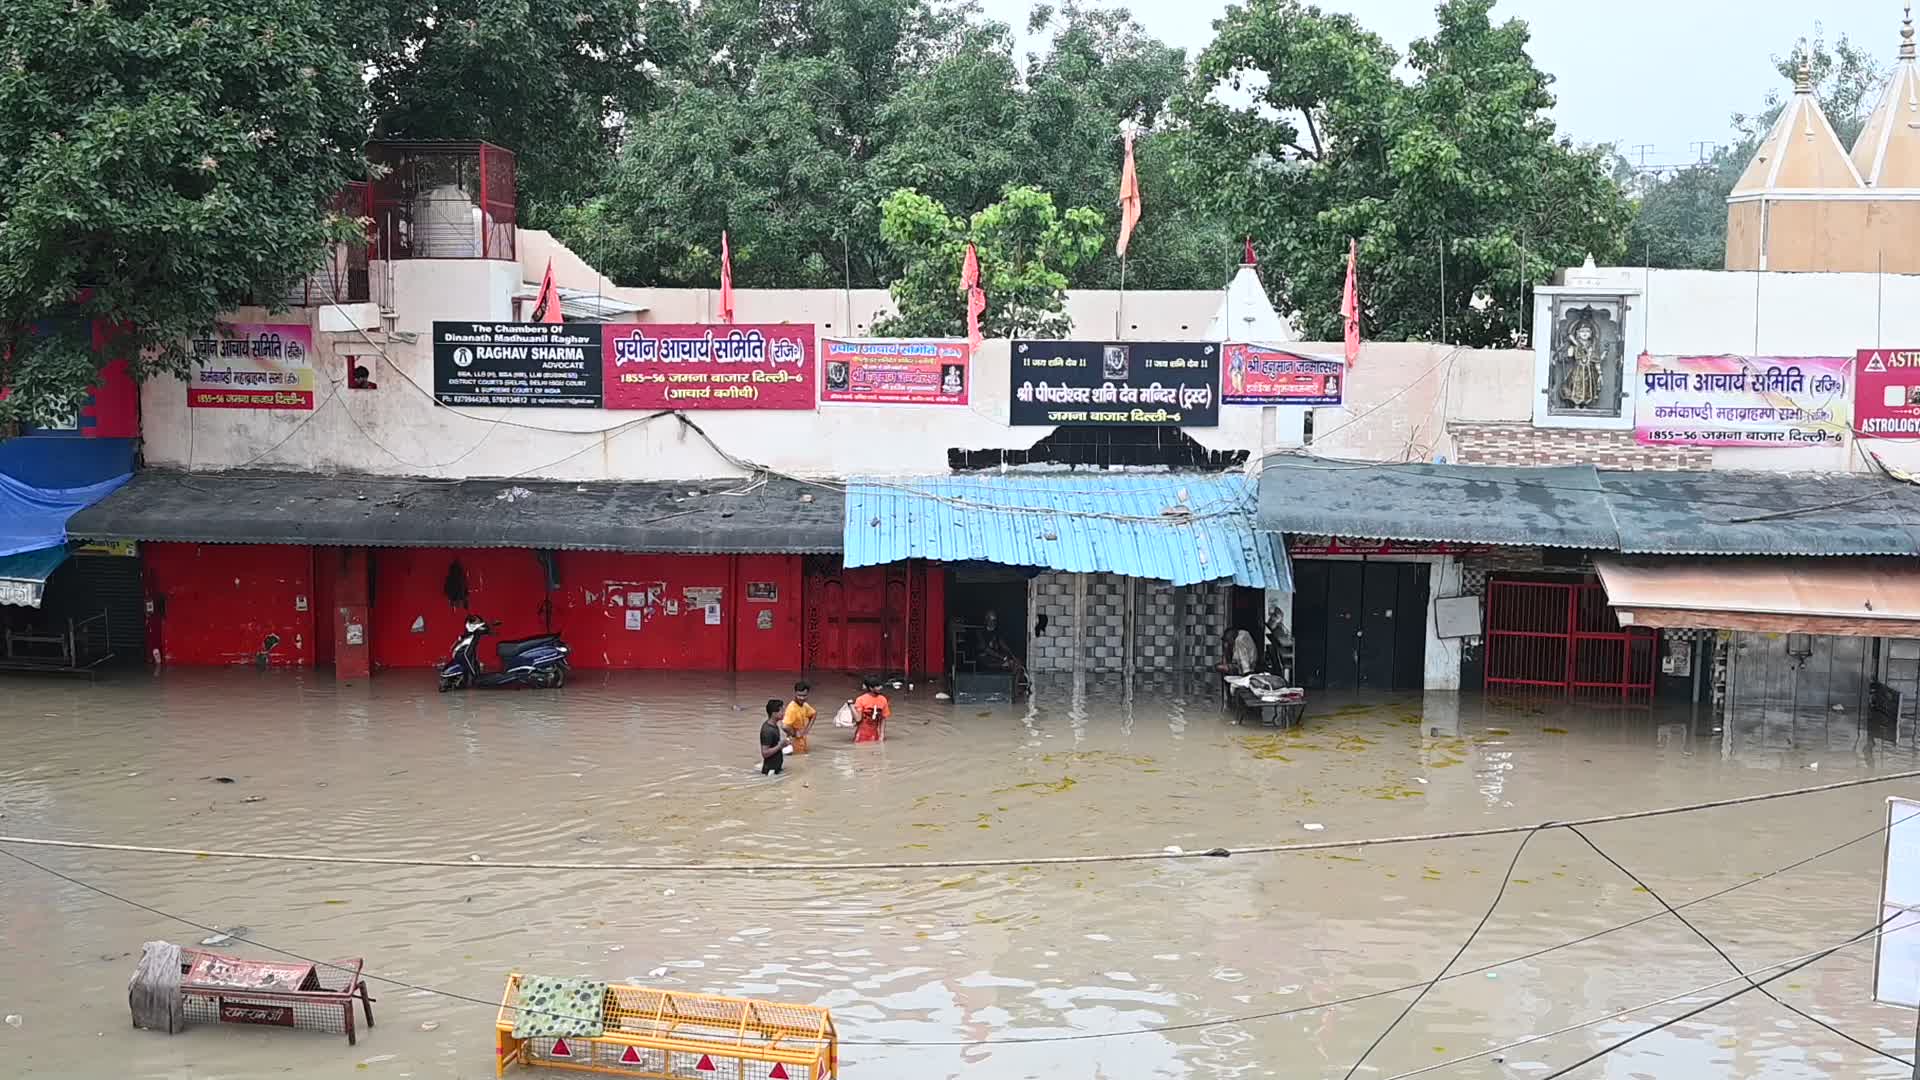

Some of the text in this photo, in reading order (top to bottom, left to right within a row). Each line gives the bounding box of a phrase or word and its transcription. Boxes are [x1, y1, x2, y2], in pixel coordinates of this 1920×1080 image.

[472, 325, 563, 334] The Chambers Of
[251, 333, 282, 358] समिति
[444, 334, 492, 342] Dinanath
[551, 335, 590, 345] Raghav
[660, 330, 711, 362] आचार्य
[714, 330, 766, 362] समिति
[476, 347, 585, 361] RAGHAV SHARMA
[620, 374, 665, 383] 1855-56
[669, 373, 708, 383] जमना
[1692, 366, 1747, 393] आचार्य
[1751, 366, 1804, 393] समिति
[1016, 381, 1033, 403] श्री
[1035, 381, 1091, 403] पीपलेश्वर
[1092, 382, 1117, 404] शनि
[1119, 383, 1138, 404] देव
[1140, 382, 1177, 404] मन्दिर
[1048, 411, 1087, 422] जमना
[1090, 411, 1128, 422] बाजार
[1655, 402, 1713, 421] कर्मकाण्डी
[1649, 430, 1697, 441] 1855-56
[1701, 431, 1741, 441] जमना
[1745, 430, 1785, 441] बाजार
